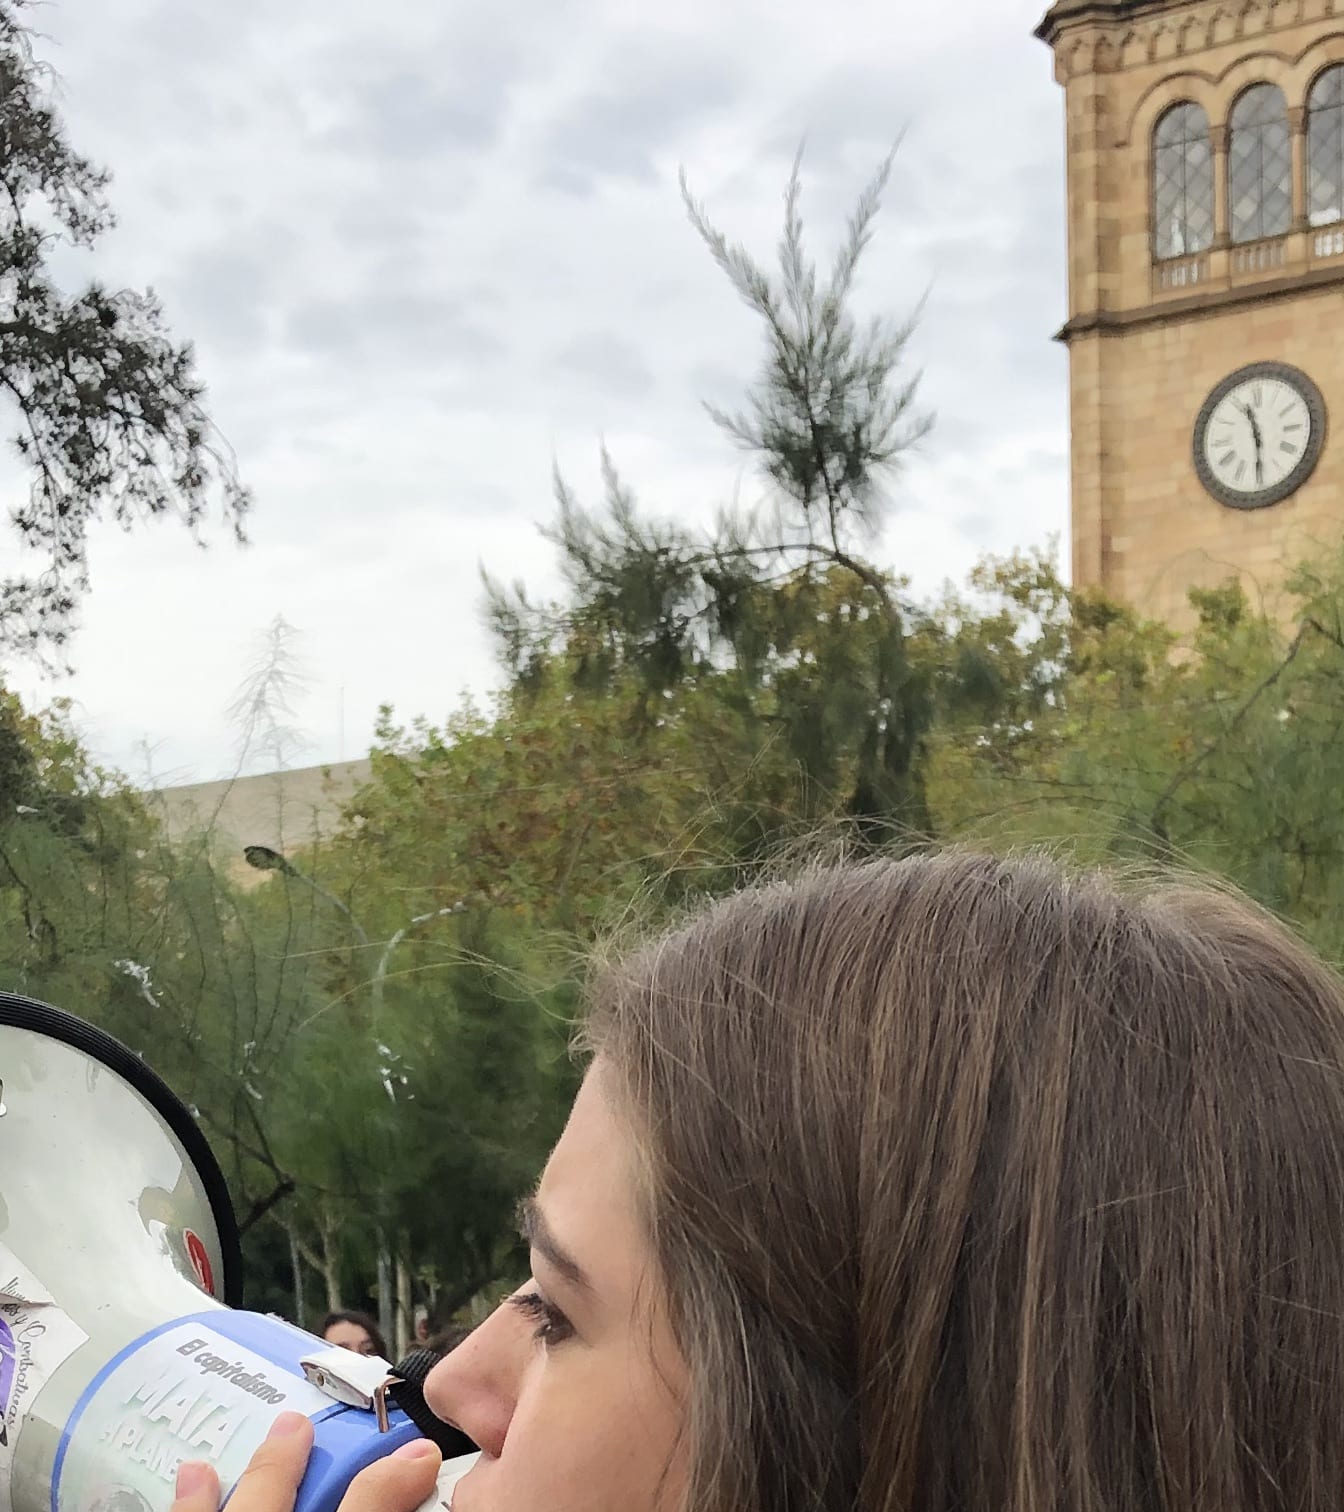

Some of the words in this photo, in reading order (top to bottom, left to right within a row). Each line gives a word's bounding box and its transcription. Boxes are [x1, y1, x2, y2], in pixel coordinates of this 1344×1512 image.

[176, 1338, 209, 1356] El
[193, 1350, 287, 1405] capitalismo
[123, 1372, 250, 1461] MATA
[113, 1423, 185, 1484] PLANE
